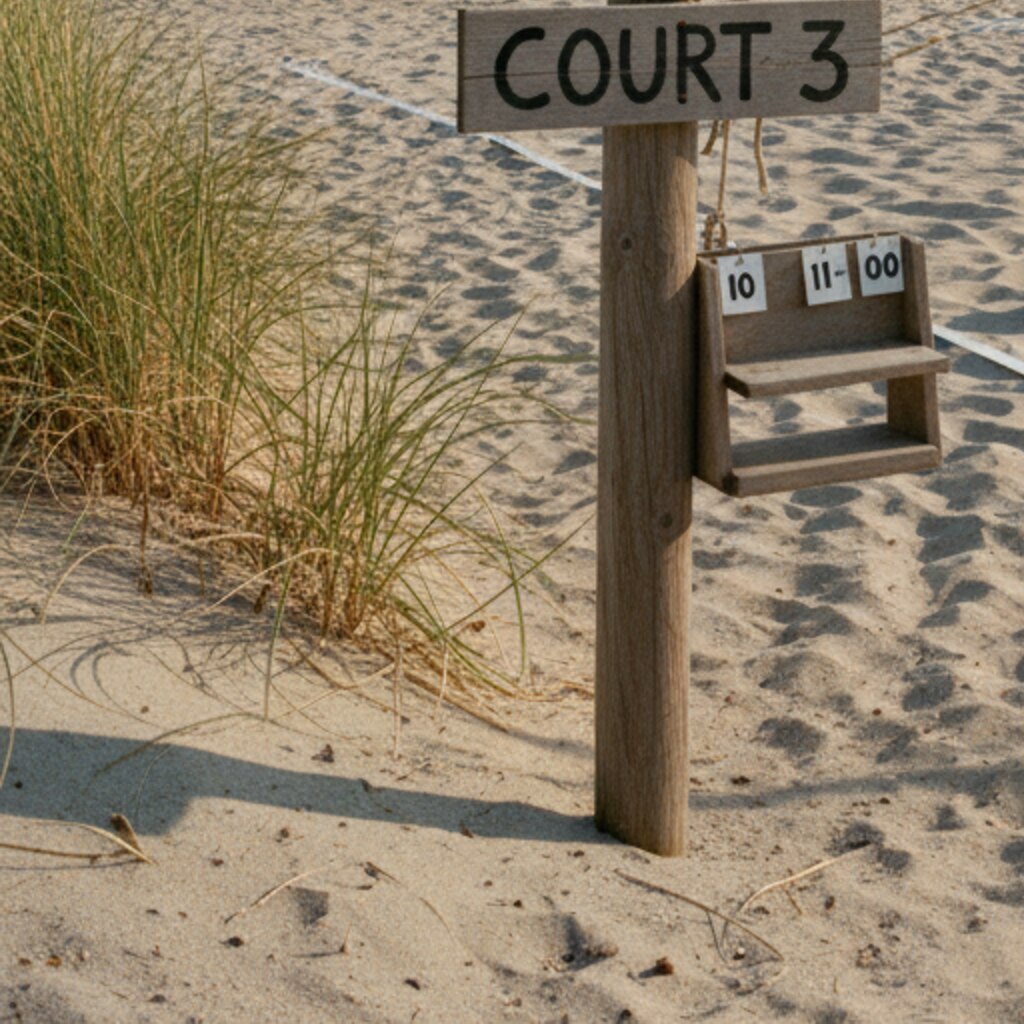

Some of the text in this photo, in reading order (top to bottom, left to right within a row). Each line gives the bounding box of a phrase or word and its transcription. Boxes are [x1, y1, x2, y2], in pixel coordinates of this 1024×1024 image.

[494, 20, 849, 110] COURT 3
[728, 272, 755, 301] 10
[864, 252, 899, 280] 00
